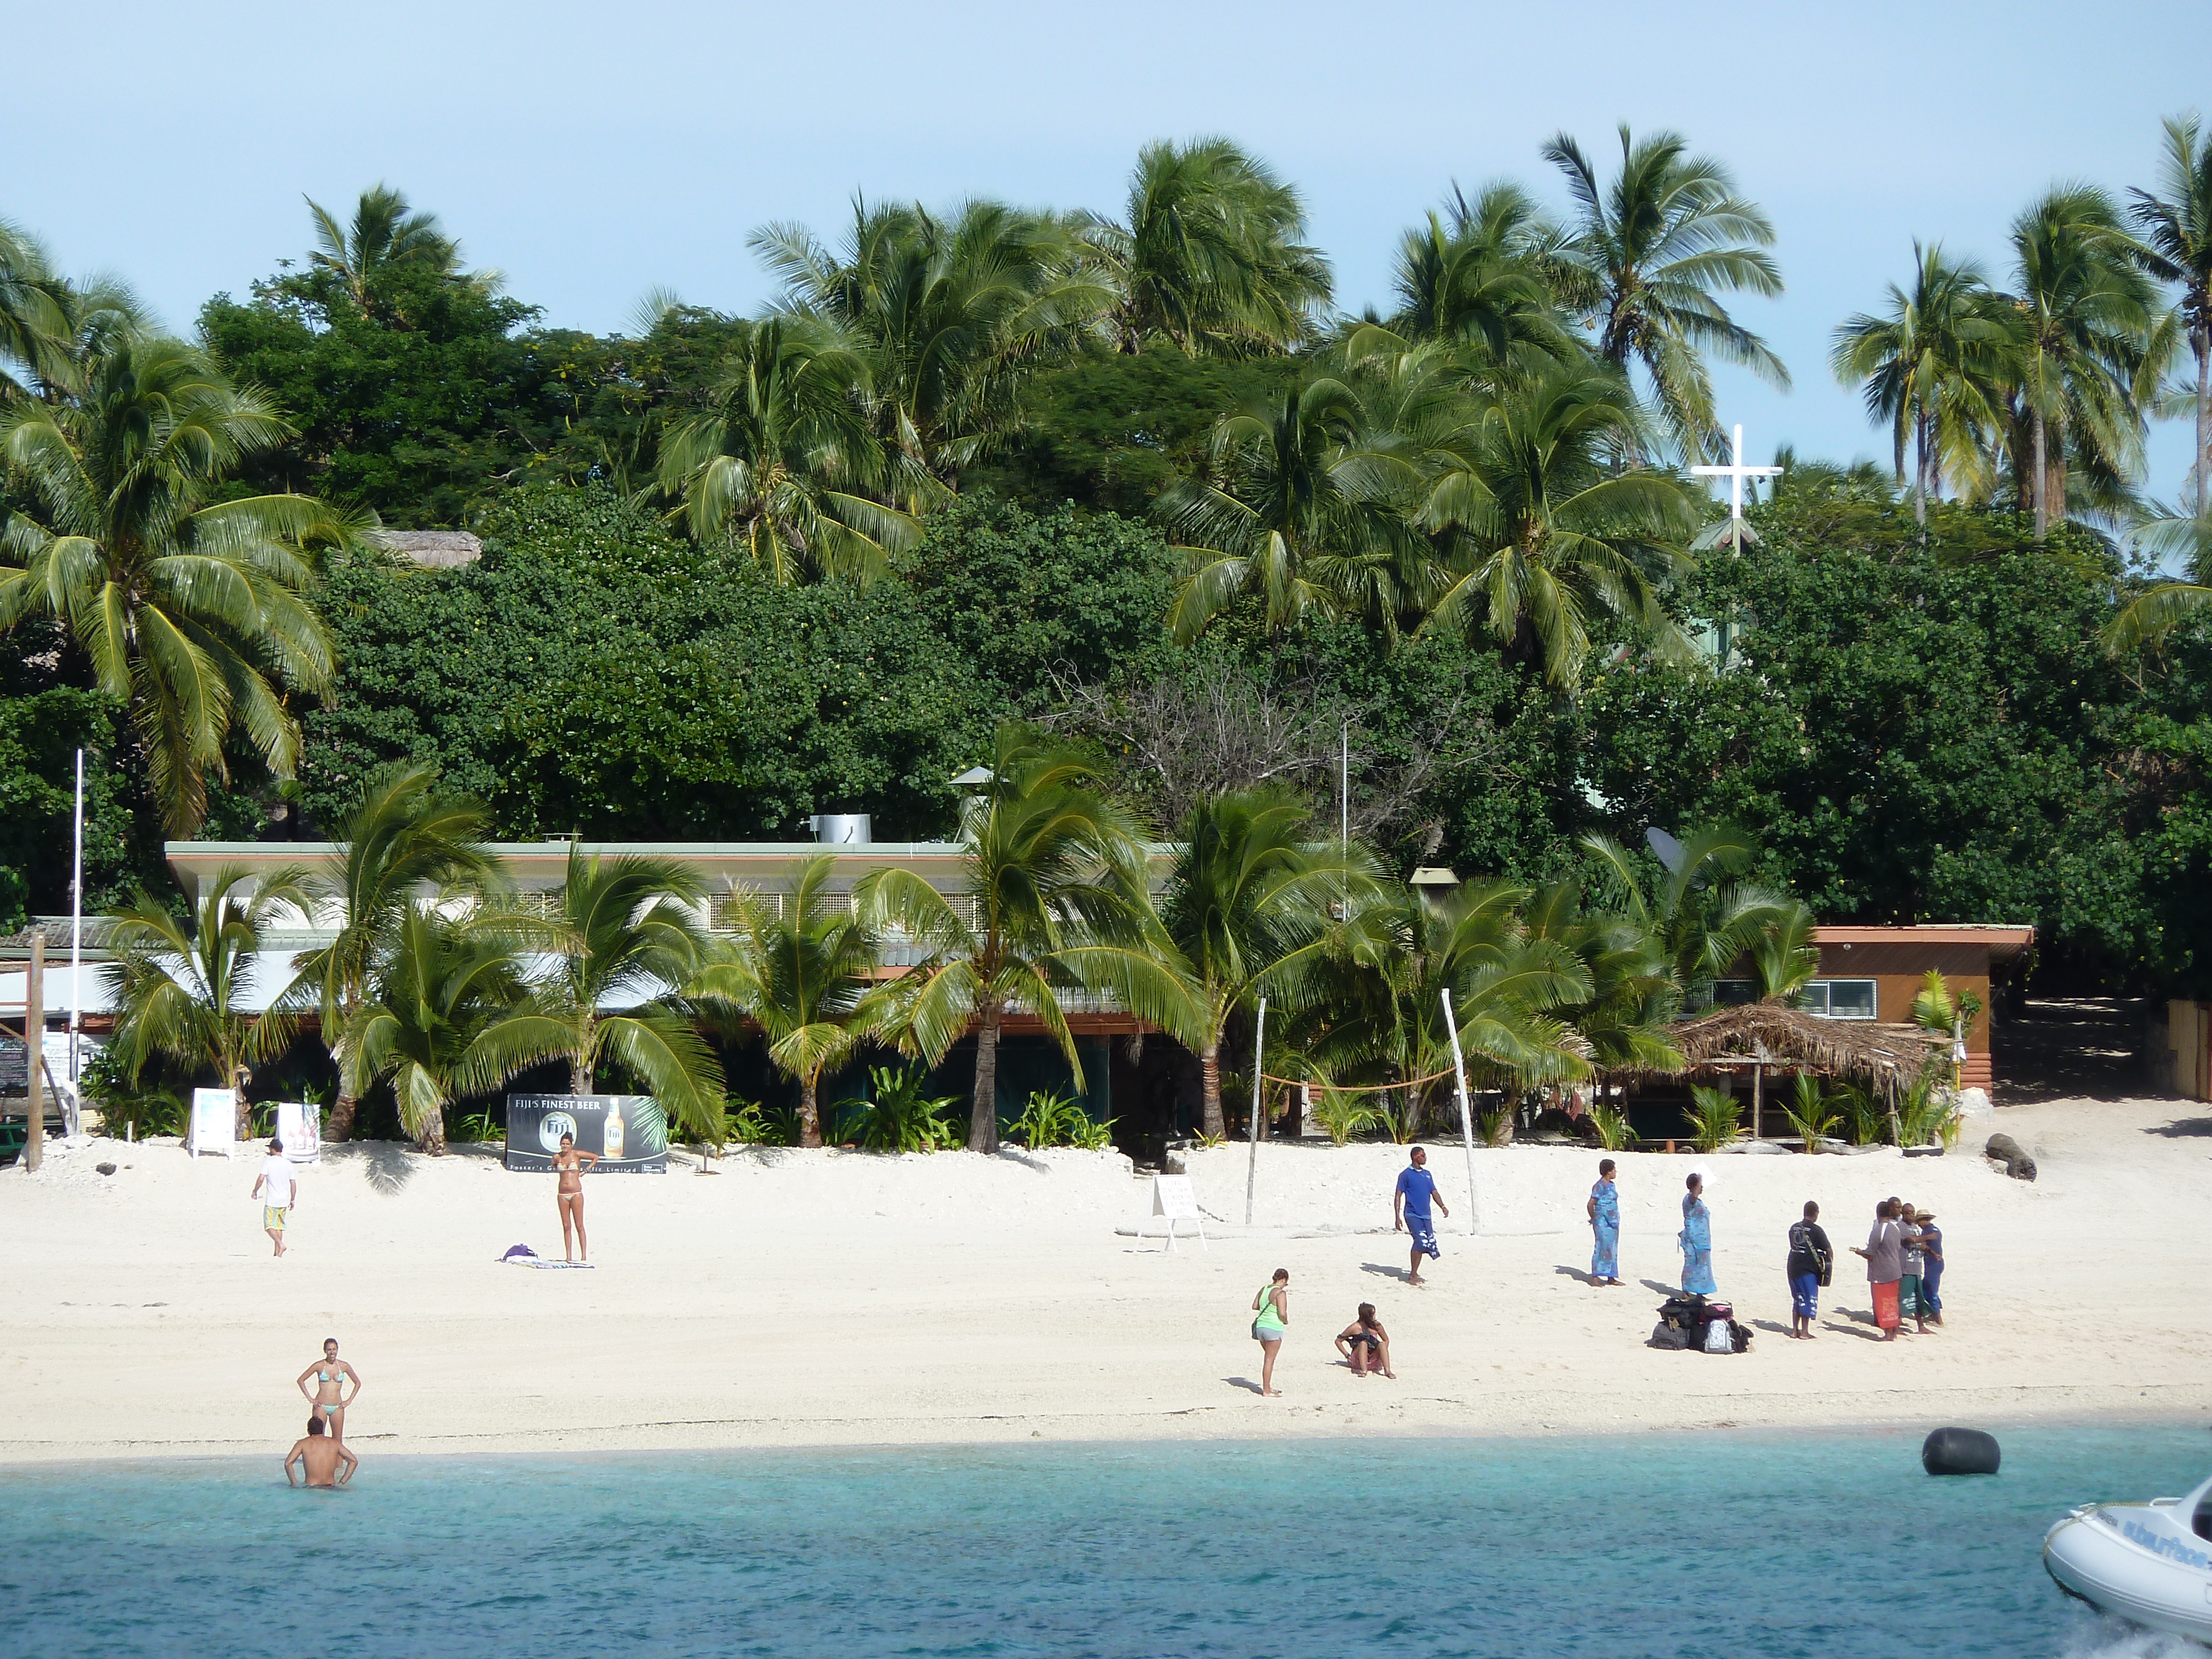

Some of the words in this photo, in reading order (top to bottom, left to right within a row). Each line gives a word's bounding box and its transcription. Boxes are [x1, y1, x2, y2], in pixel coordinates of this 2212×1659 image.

[515, 1100, 539, 1109] FIJI'S
[541, 1100, 575, 1109] FINEST
[577, 1100, 601, 1110] BEER
